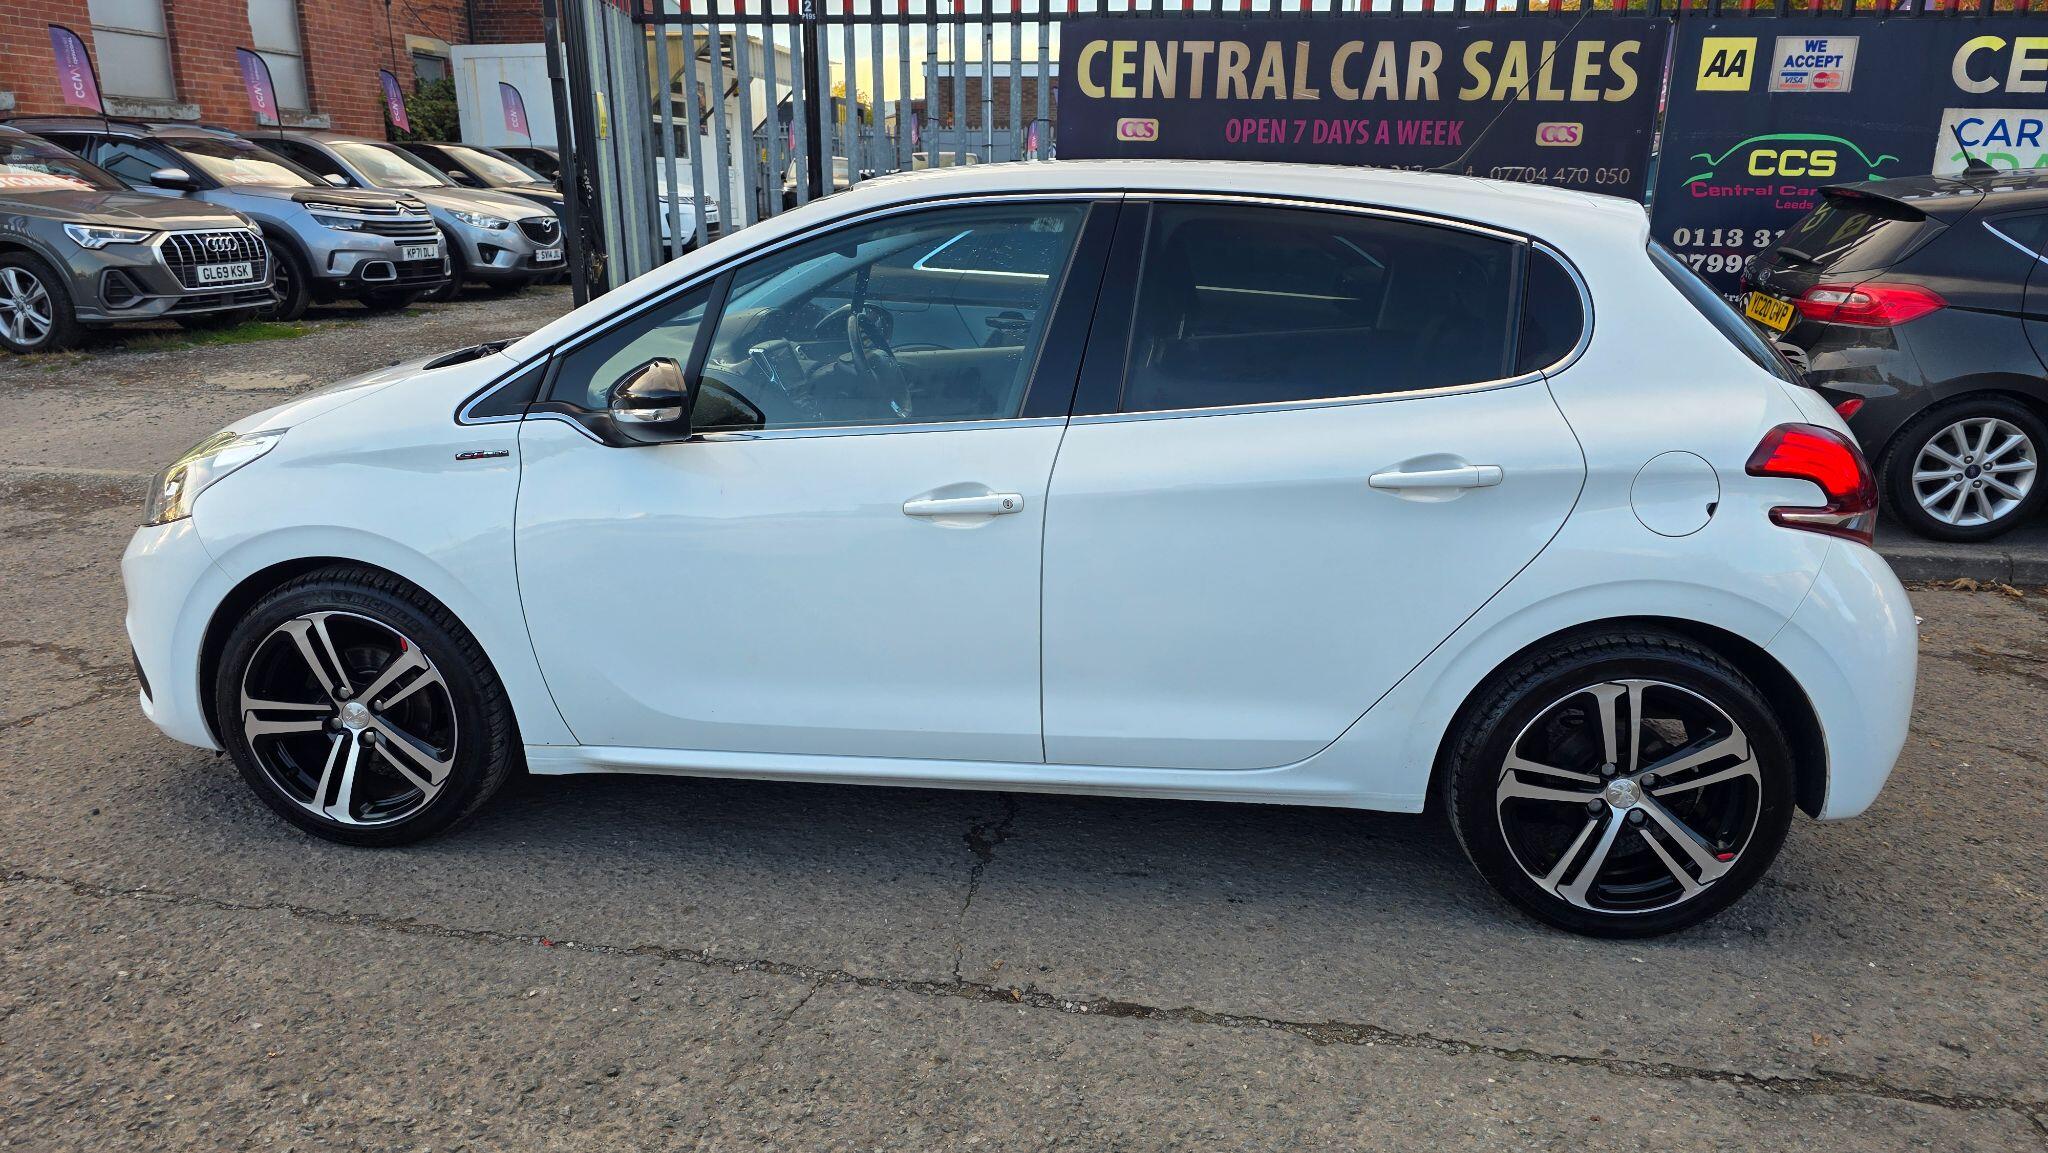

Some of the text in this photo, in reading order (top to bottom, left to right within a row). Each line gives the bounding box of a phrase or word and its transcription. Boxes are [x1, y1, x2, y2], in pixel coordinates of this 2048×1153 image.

[804, 0, 812, 11] 2
[1805, 39, 1828, 53] WE
[1703, 49, 1748, 78] AA
[1783, 55, 1844, 68] ACCEPT
[1077, 40, 1320, 99] CENTRAL
[1330, 40, 1443, 100] CAR
[1458, 40, 1641, 102] SALES
[1784, 76, 1804, 84] VISA
[1121, 121, 1155, 139] CCS
[1225, 118, 1465, 146] OPEN 7 DAYS A WEEK
[1541, 125, 1578, 144] CCS
[1955, 117, 2044, 148] CAR
[1747, 149, 1838, 177] CCS
[1490, 166, 1548, 183] 07704
[1552, 167, 1589, 184] 470
[1595, 167, 1631, 185] 050
[1691, 181, 1818, 198] Central Car
[1775, 199, 1813, 210] Leeds
[1673, 227, 1744, 247] 0113
[406, 247, 423, 259] KP71
[202, 264, 249, 280] GL69 KSK
